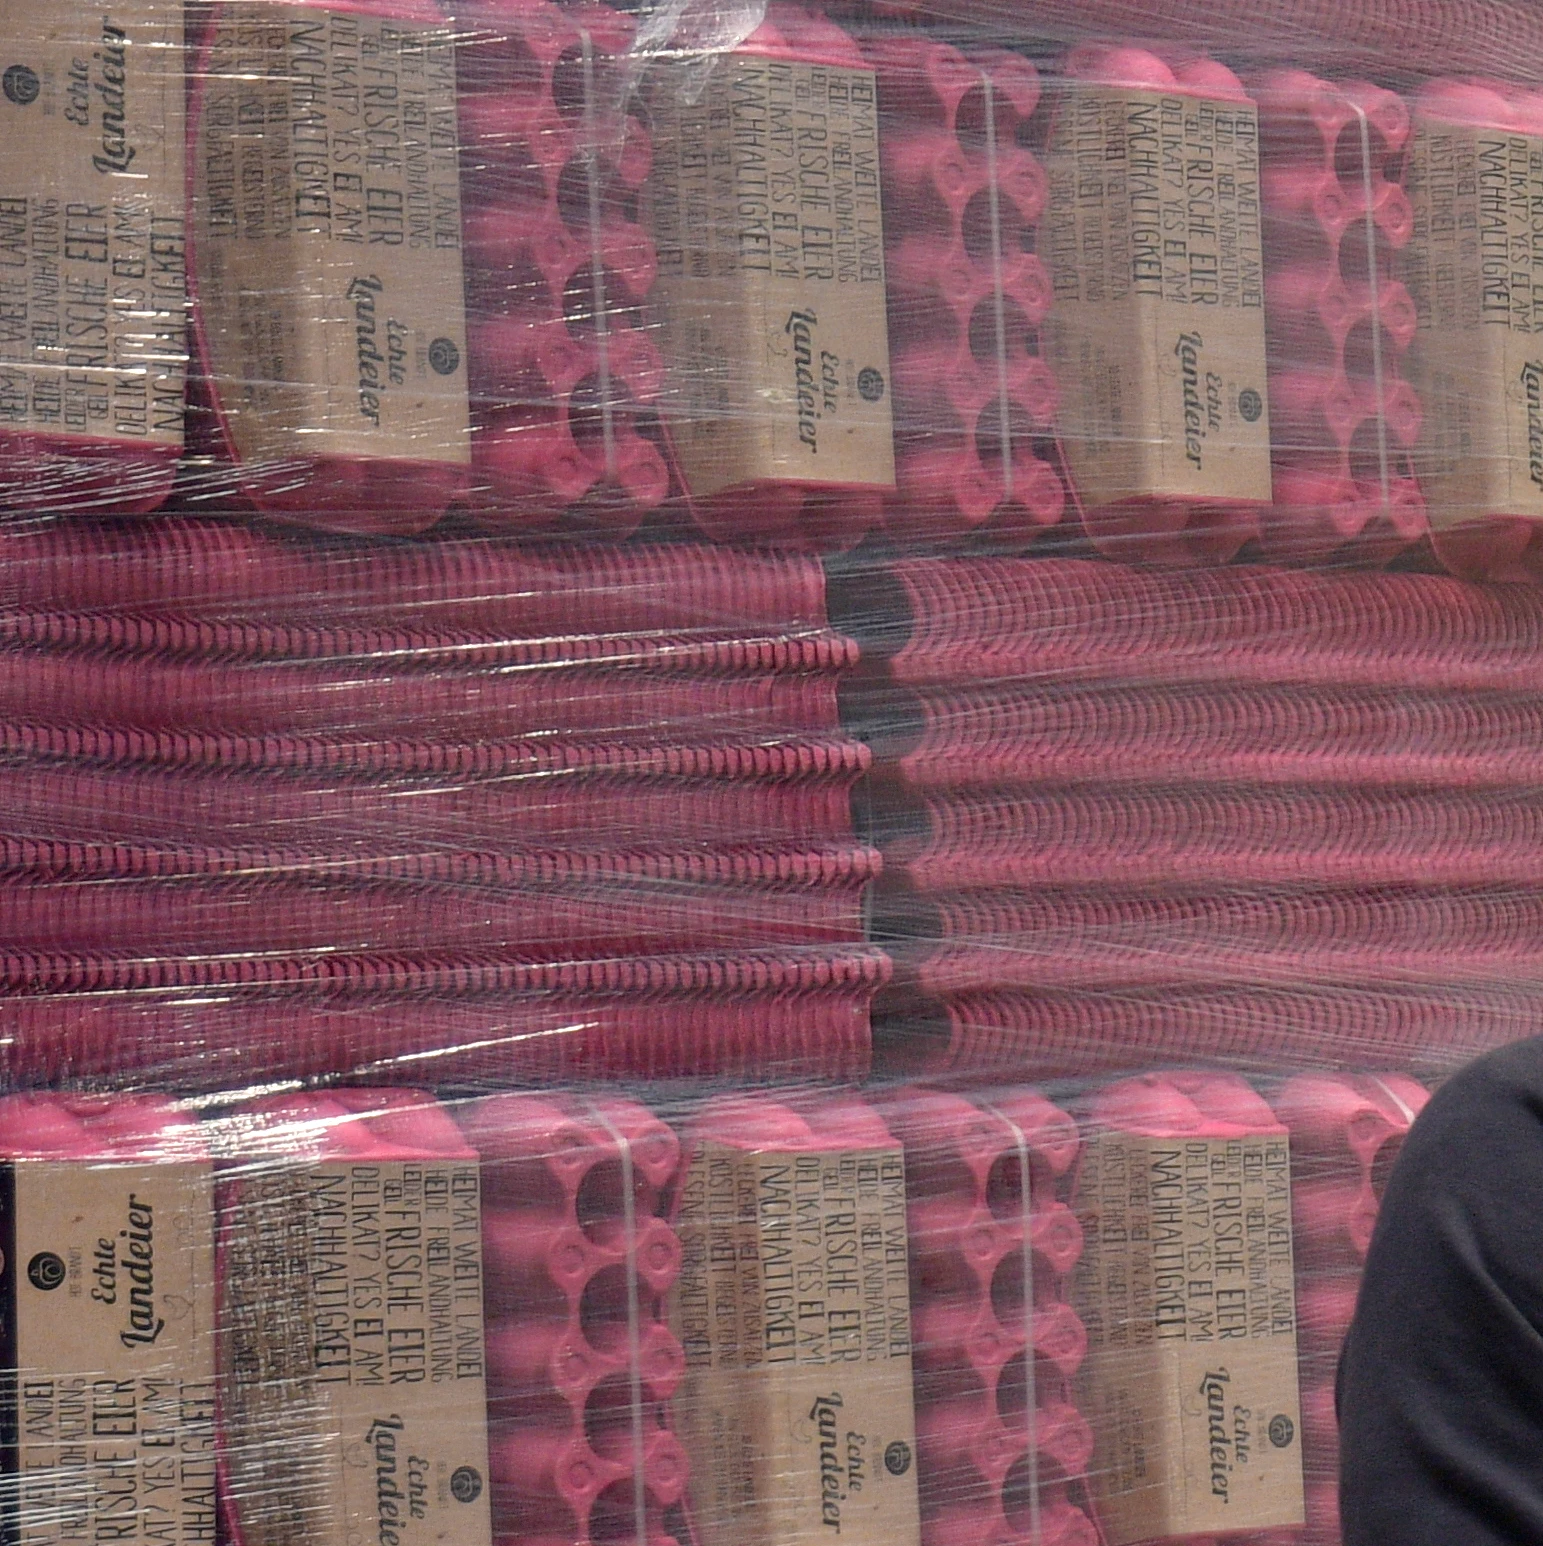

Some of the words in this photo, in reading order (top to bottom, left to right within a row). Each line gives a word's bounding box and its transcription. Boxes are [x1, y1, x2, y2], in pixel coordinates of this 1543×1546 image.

[95, 10, 134, 172] Landeier
[363, 65, 400, 176] FRISCHE
[734, 69, 771, 276] NACHHALTIGKEIT
[796, 110, 830, 214] FRISCHE
[1185, 143, 1215, 242] FRISCHE
[365, 186, 402, 247] EIER
[1128, 104, 1161, 301] NACHHALTIGKEIT
[1480, 141, 1508, 330] NACHHALTIGKEIT
[801, 225, 833, 281] EIER
[1188, 252, 1217, 307] EIER
[346, 276, 383, 428] Landeier
[385, 319, 406, 386] Echte
[787, 309, 820, 453] Landeier
[820, 350, 839, 412] Echte
[1175, 333, 1204, 470] Landeier
[1204, 372, 1222, 431] Echte
[351, 1168, 380, 1260] DELIKAT?
[426, 1169, 450, 1213] HEIDE
[452, 1168, 480, 1232] HEIMAT
[1212, 1182, 1244, 1276] FRISCHE
[94, 1238, 118, 1304] Echte
[122, 1193, 162, 1348] Landeier
[311, 1175, 351, 1385] NACHHALTIGKEIT
[385, 1211, 424, 1314] FRISCHE
[453, 1241, 480, 1302] WEITE
[760, 1165, 796, 1364] NACHHALTIGKEIT
[823, 1197, 857, 1296] FRISCHE
[1152, 1151, 1186, 1341] NACHHALTIGKEIT
[354, 1273, 380, 1309] YES
[354, 1319, 381, 1338] EI
[428, 1227, 452, 1382] FREILANDHALTUNG
[1215, 1289, 1246, 1339] EIER
[355, 1349, 383, 1385] AM!
[388, 1329, 425, 1384] EIER
[454, 1314, 482, 1379] LANDEI
[827, 1310, 859, 1362] EIER
[94, 1379, 136, 1436] EIER
[1200, 1367, 1231, 1504] Landeier
[1232, 1404, 1250, 1462] Echte
[407, 1456, 429, 1519] Echte
[811, 1392, 844, 1533] Landeier
[845, 1431, 864, 1491] Echte
